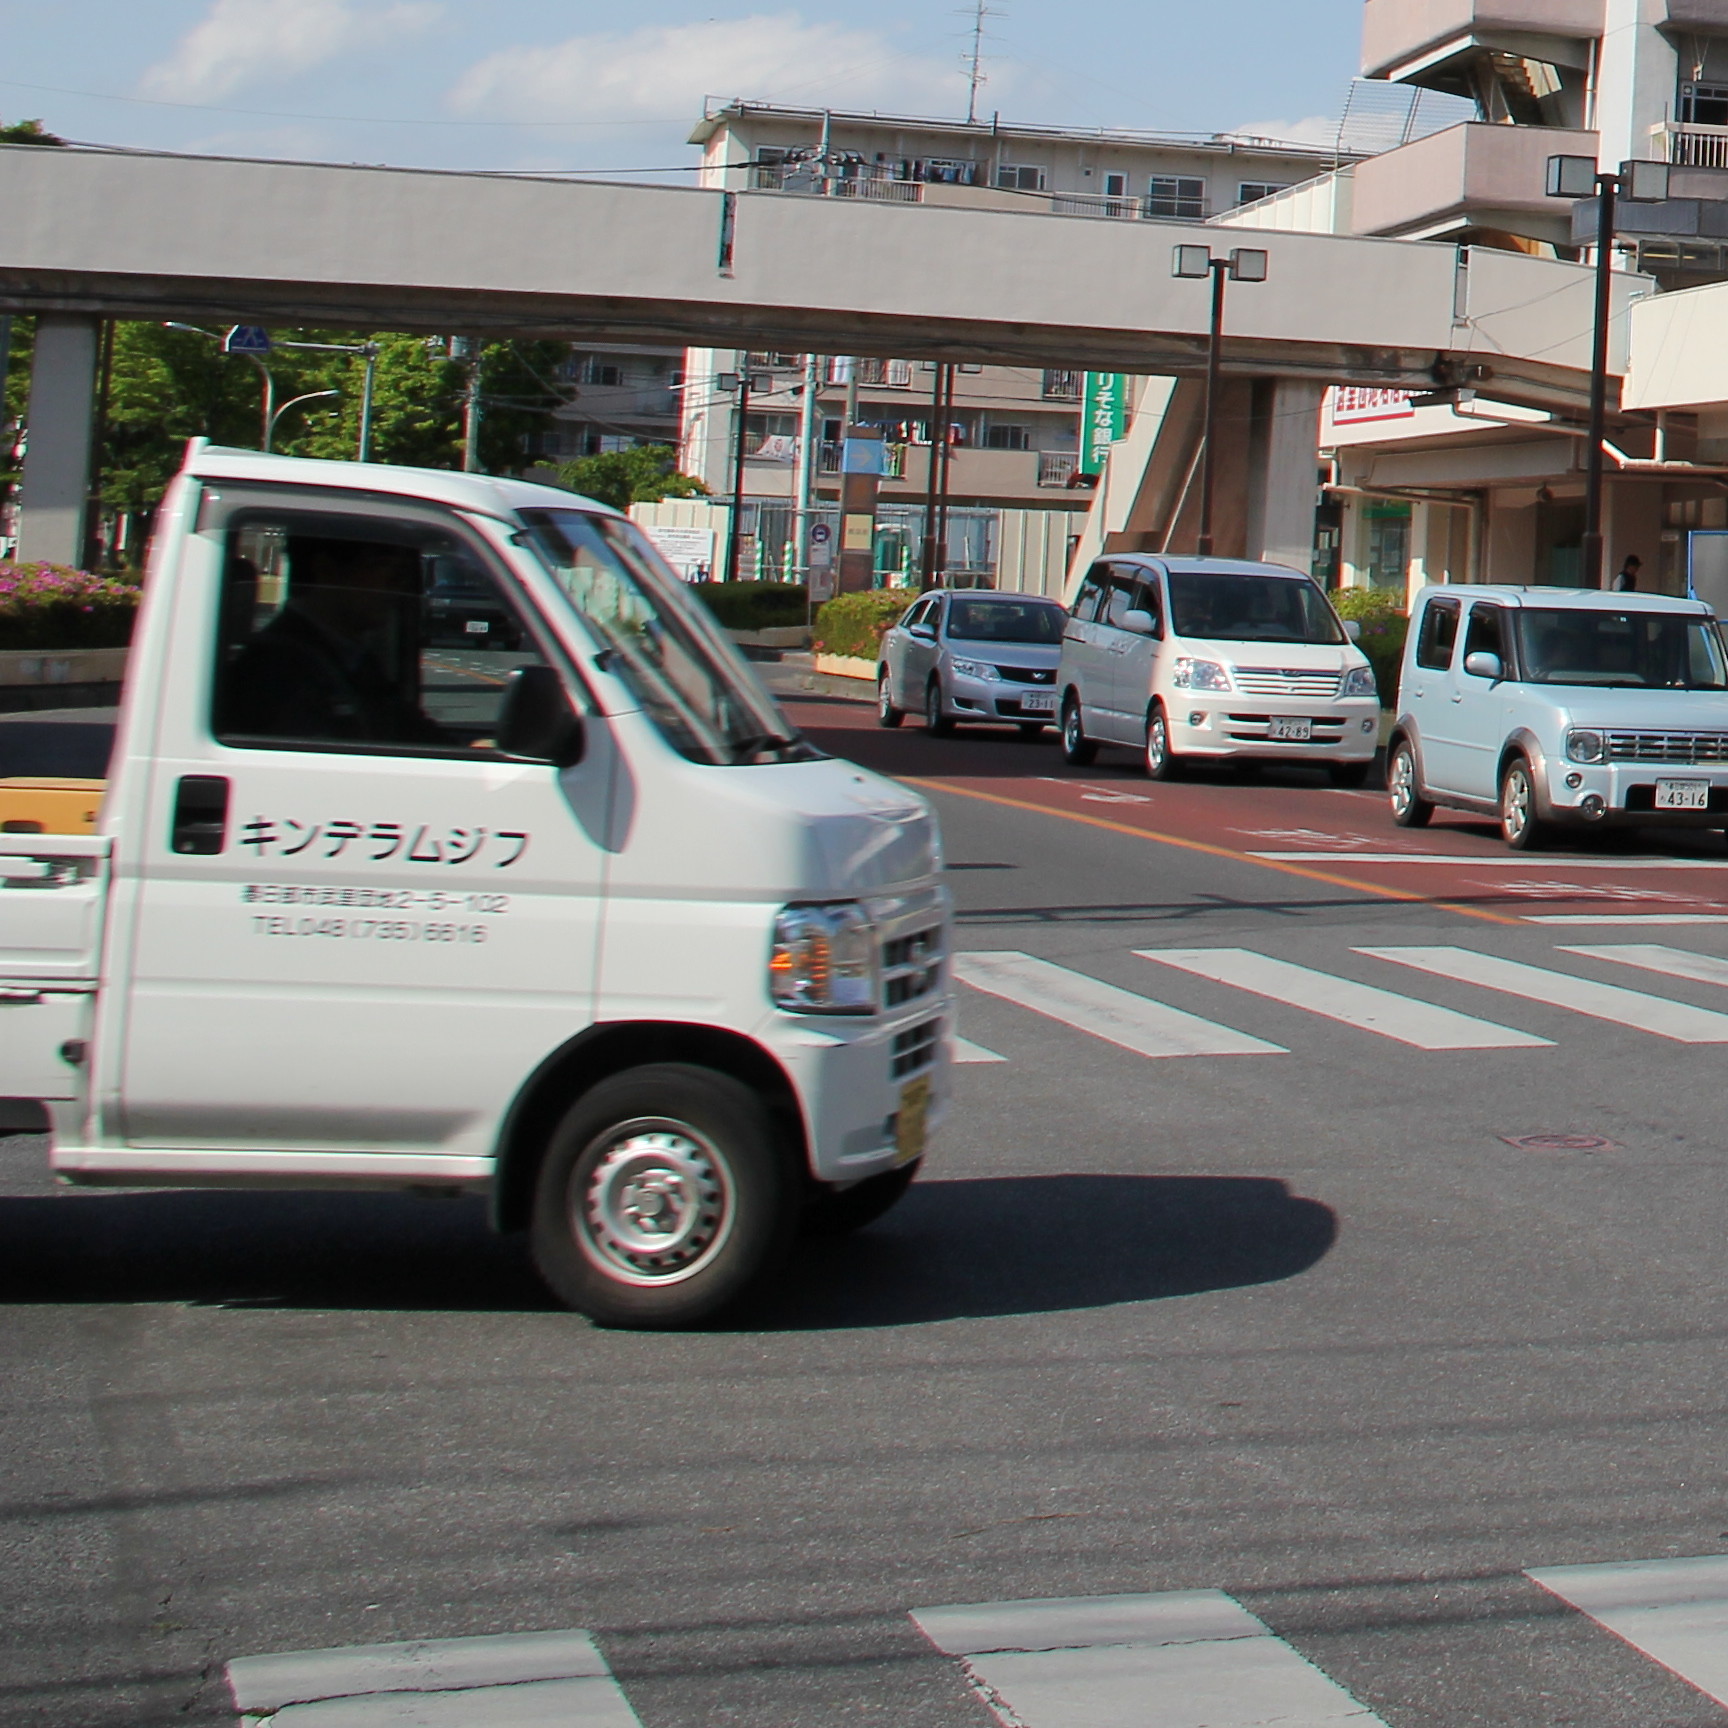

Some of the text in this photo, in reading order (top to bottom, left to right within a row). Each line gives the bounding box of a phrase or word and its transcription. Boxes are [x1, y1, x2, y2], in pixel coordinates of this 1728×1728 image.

[1091, 372, 1115, 464] りそな銀行
[1667, 792, 1705, 806] 43-16
[238, 814, 530, 868] キンデラムジフ
